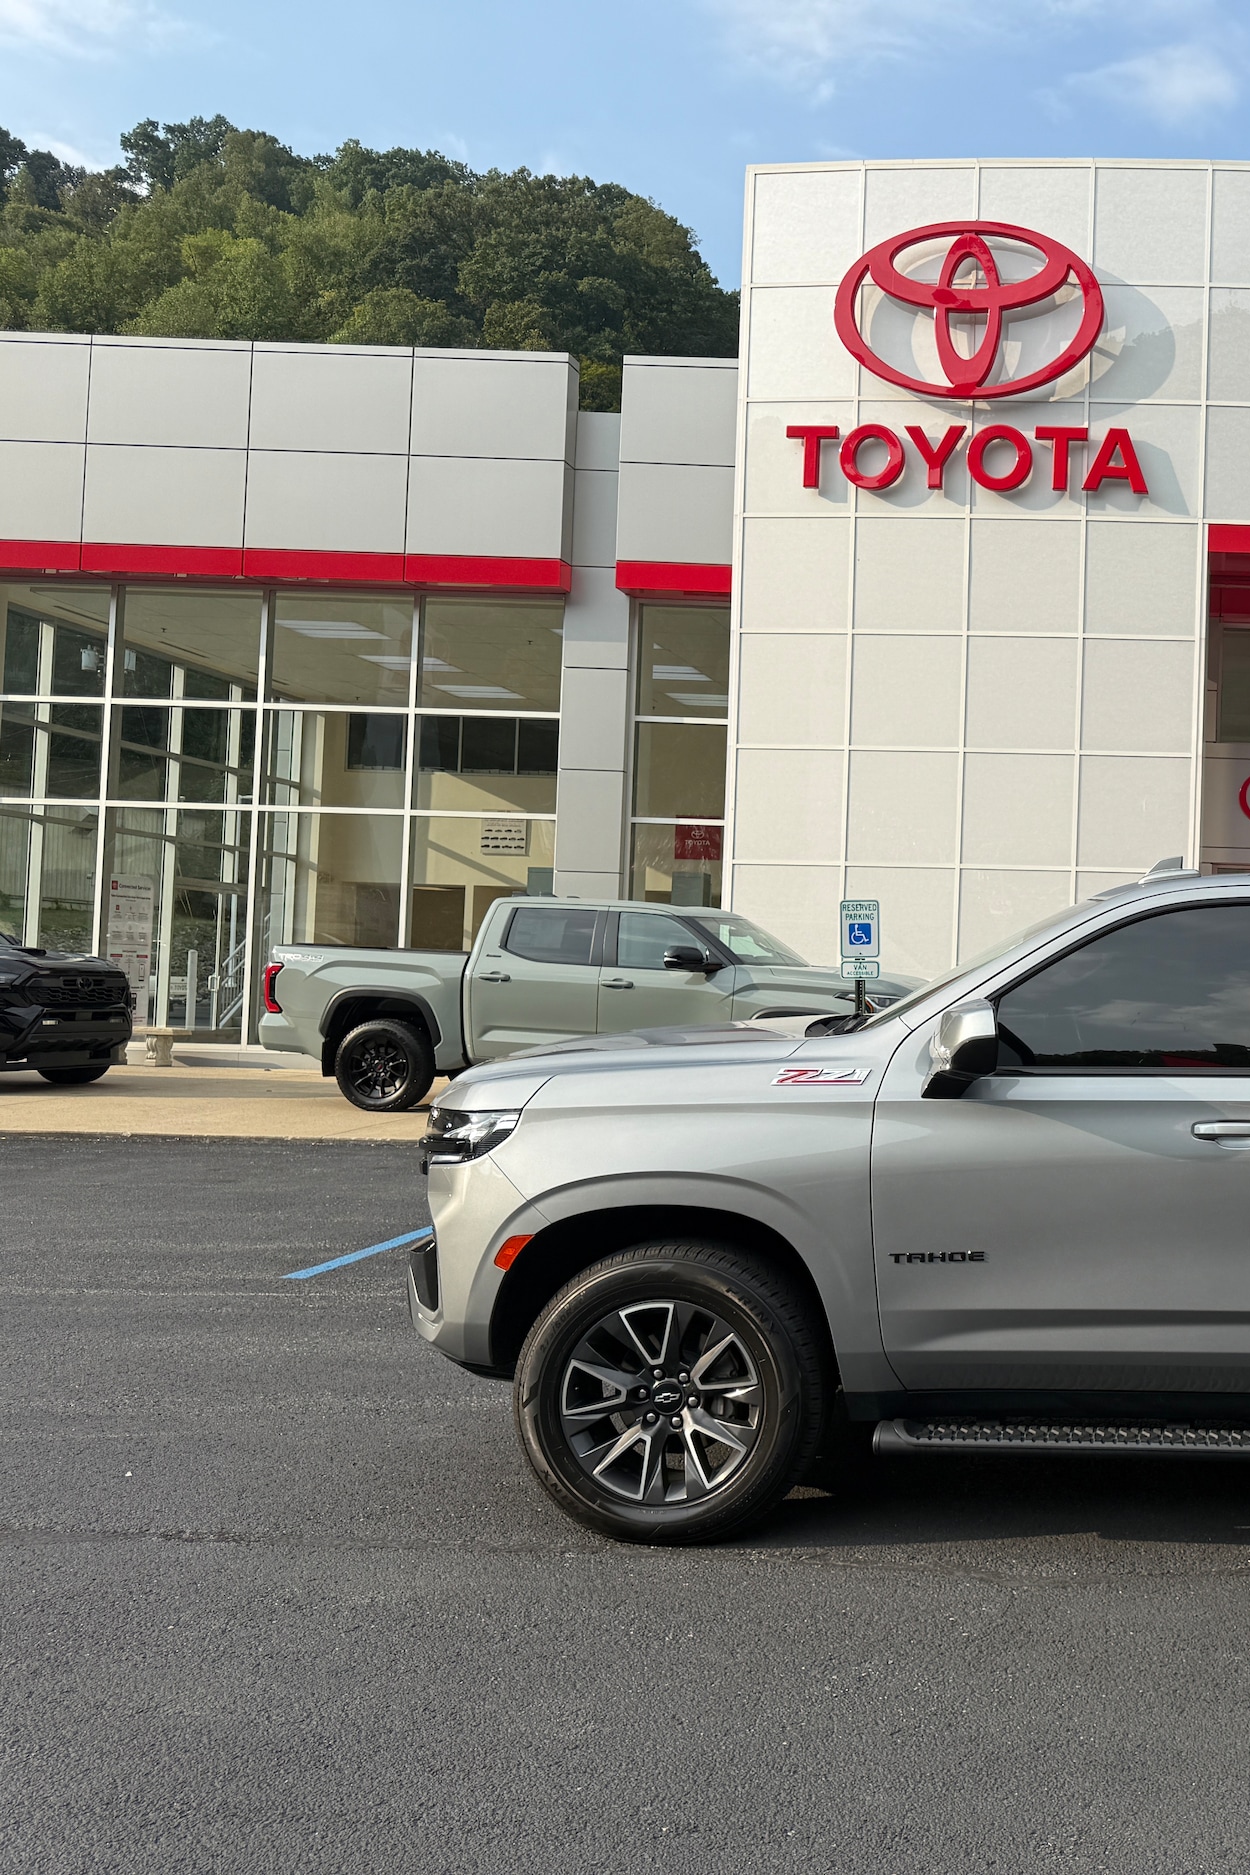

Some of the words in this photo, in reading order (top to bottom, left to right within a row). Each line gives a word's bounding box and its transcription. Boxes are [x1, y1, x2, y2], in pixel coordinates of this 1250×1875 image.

[786, 423, 1149, 494] TOYOTA
[842, 903, 877, 912] RESERVED
[845, 913, 875, 921] PARKING
[888, 1250, 985, 1264] TAHOE
[725, 1286, 780, 1335] PRINX
